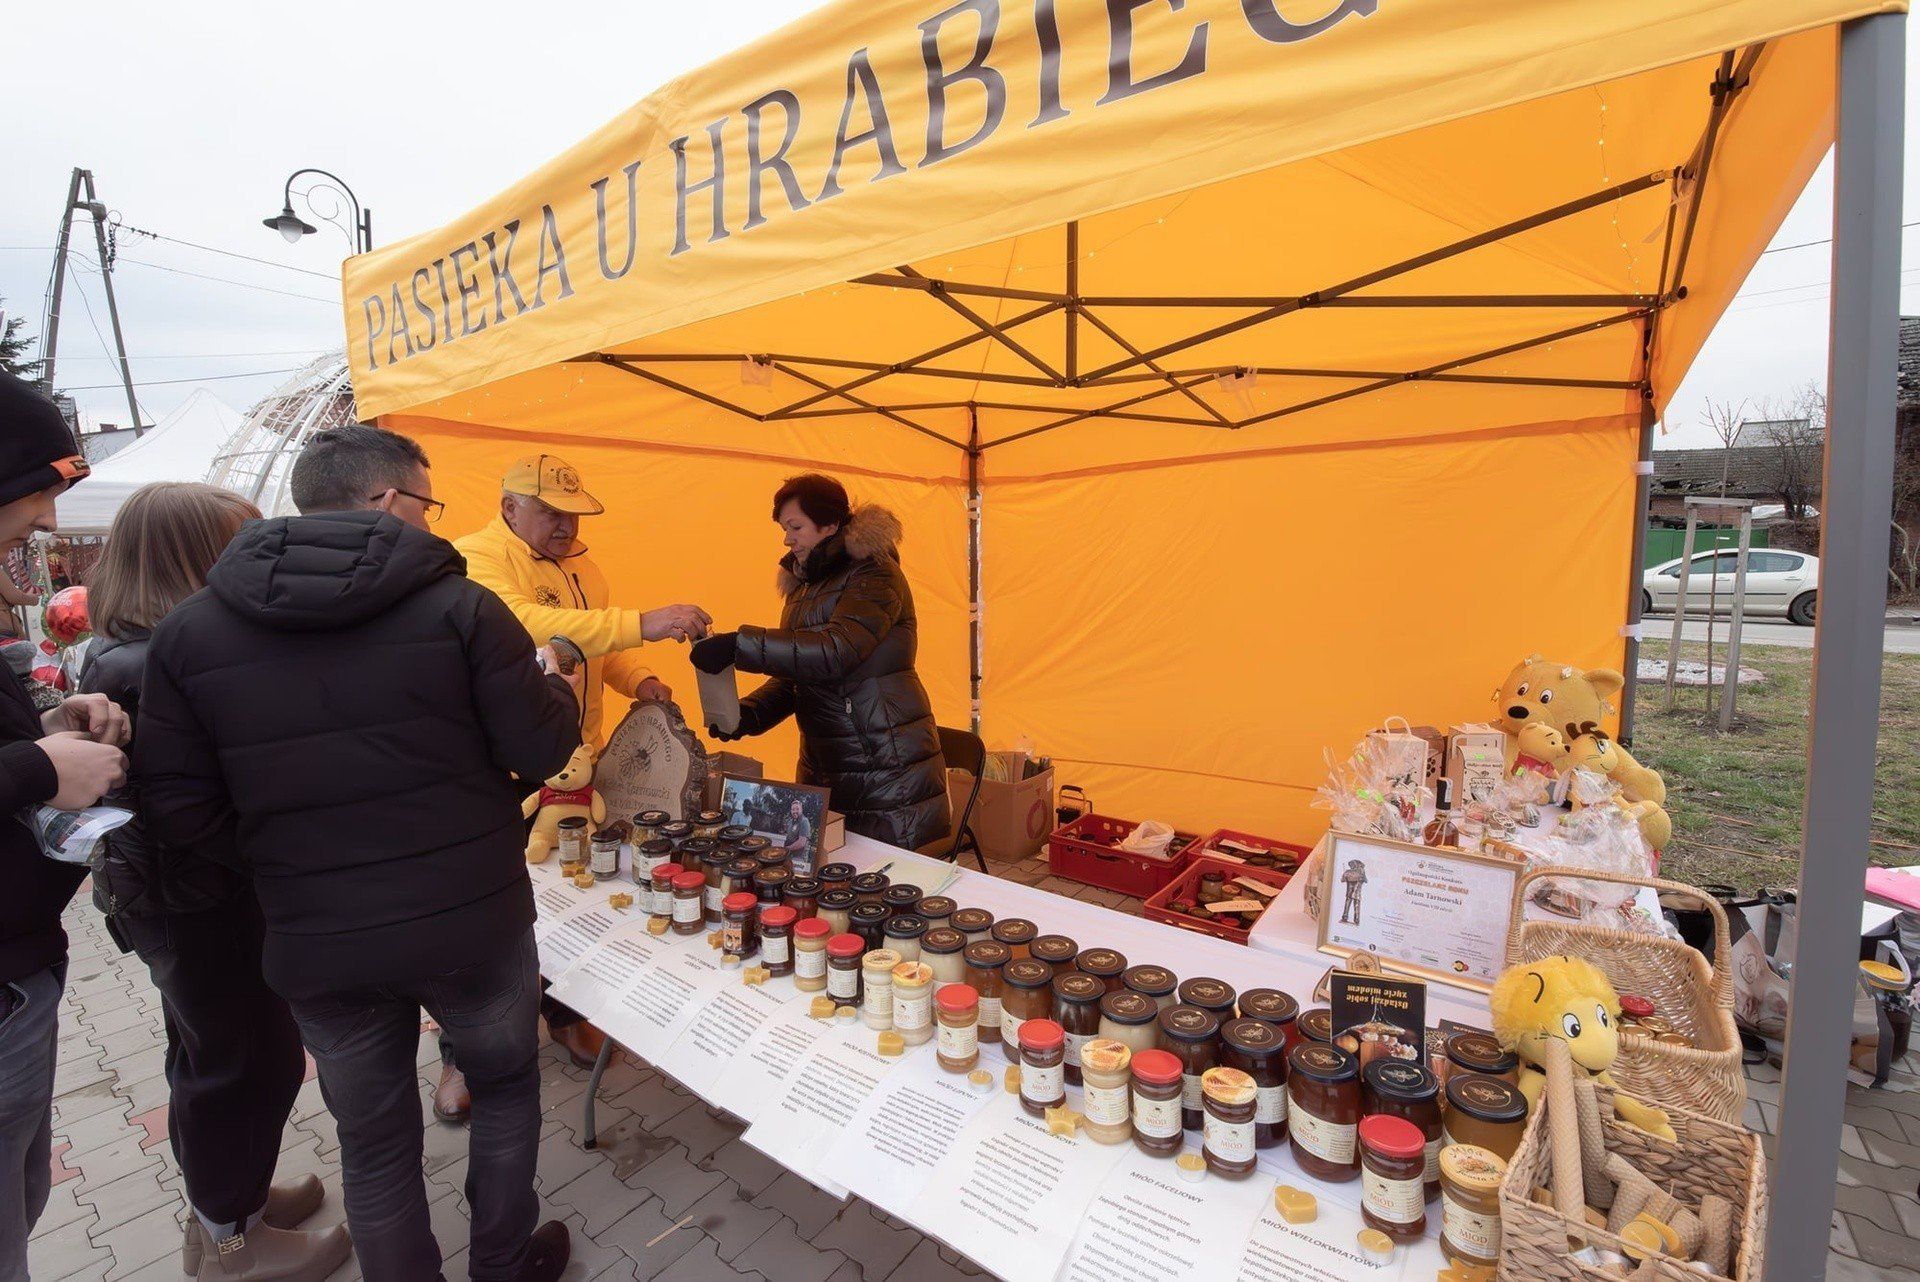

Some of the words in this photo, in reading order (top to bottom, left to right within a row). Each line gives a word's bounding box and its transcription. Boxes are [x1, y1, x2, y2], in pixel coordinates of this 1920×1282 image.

[363, 204, 575, 372] PASIEKA
[590, 161, 641, 280] U
[1403, 888, 1424, 898] Adam
[1426, 892, 1462, 906] Tarnowski
[1154, 1181, 1204, 1204] FACELIOWY
[1291, 1230, 1382, 1270] WIELOKWIATOWY
